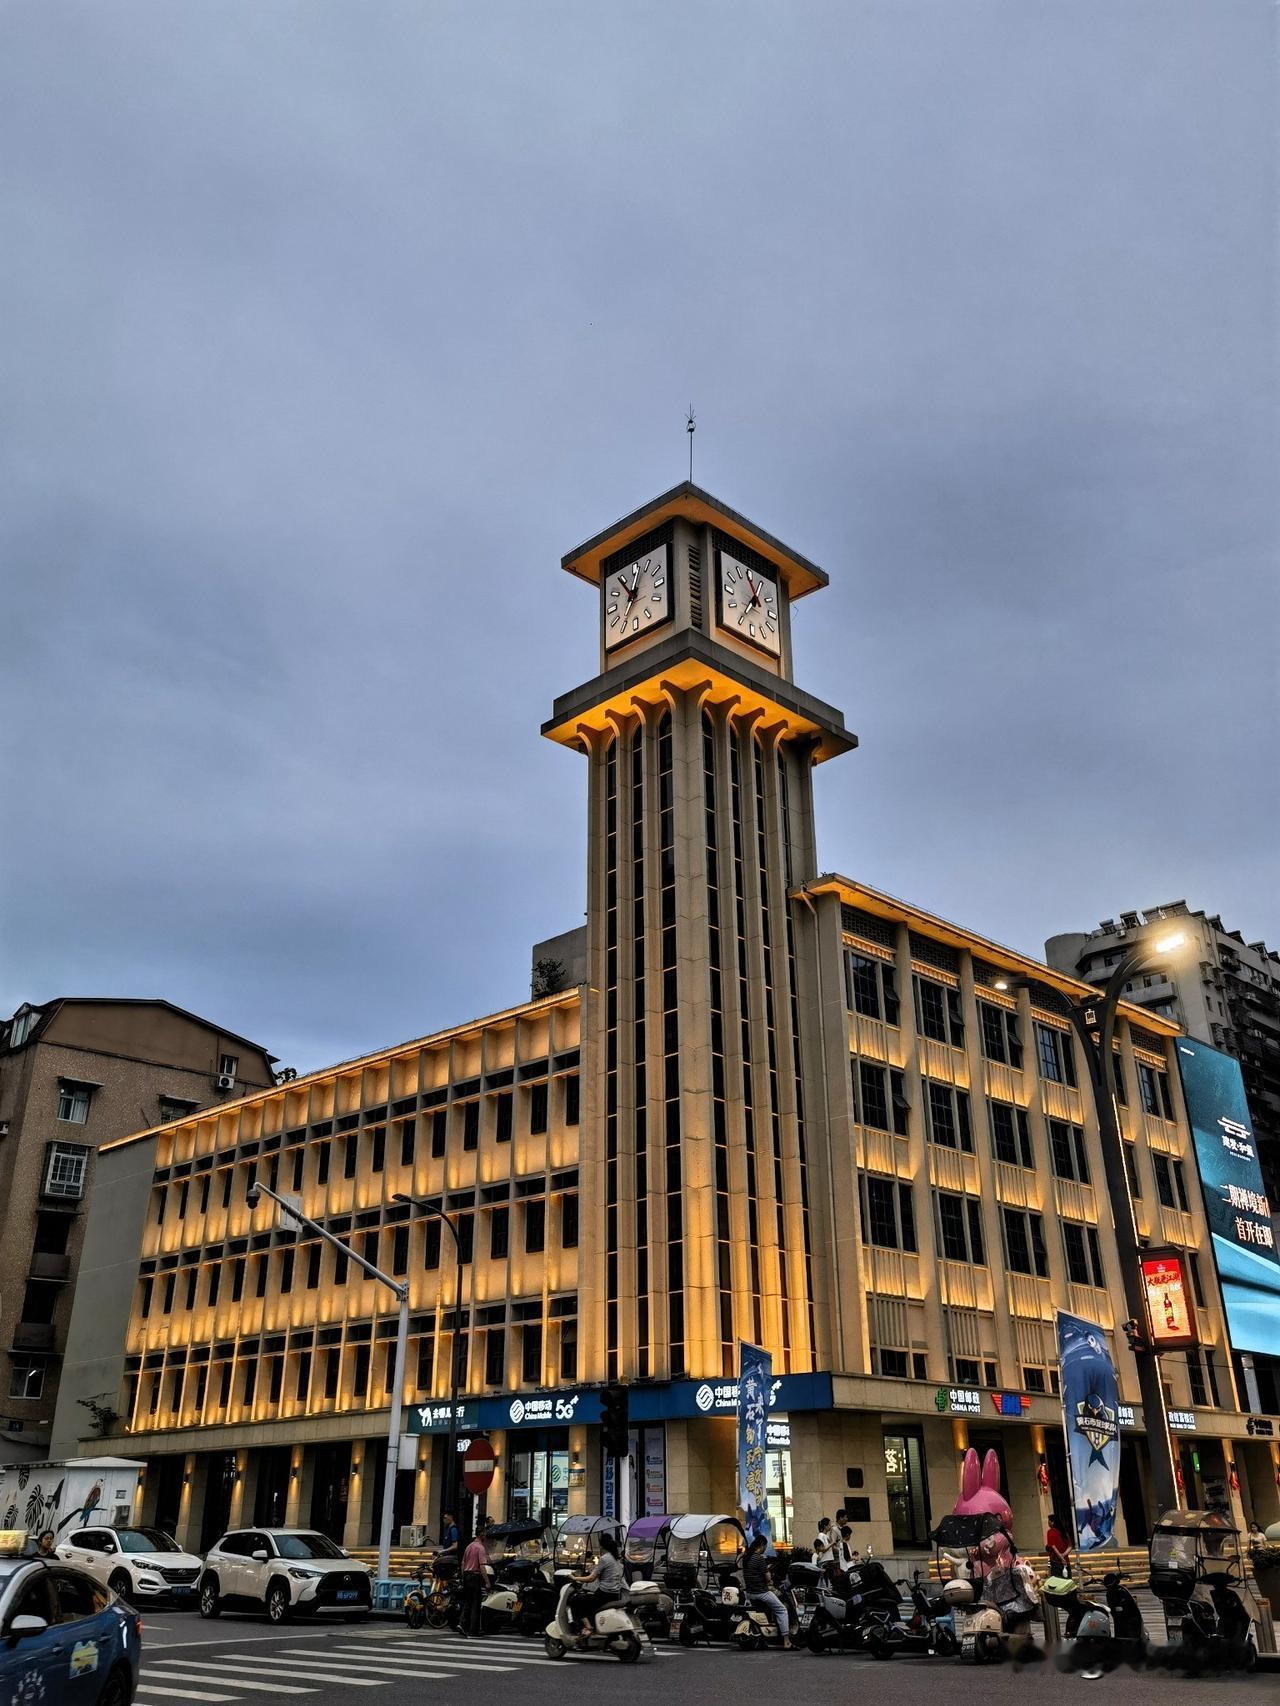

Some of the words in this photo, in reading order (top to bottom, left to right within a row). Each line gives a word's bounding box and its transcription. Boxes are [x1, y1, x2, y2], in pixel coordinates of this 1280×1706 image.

[1235, 1216, 1273, 1248] 首开在即
[949, 1388, 980, 1404] 中国邮政
[524, 1400, 552, 1412] 中国移动
[555, 1399, 574, 1419] 5G
[715, 1399, 731, 1408] China
[950, 1403, 967, 1412] CHINA
[968, 1404, 980, 1413] POST
[432, 1406, 465, 1419] 去哪儿行
